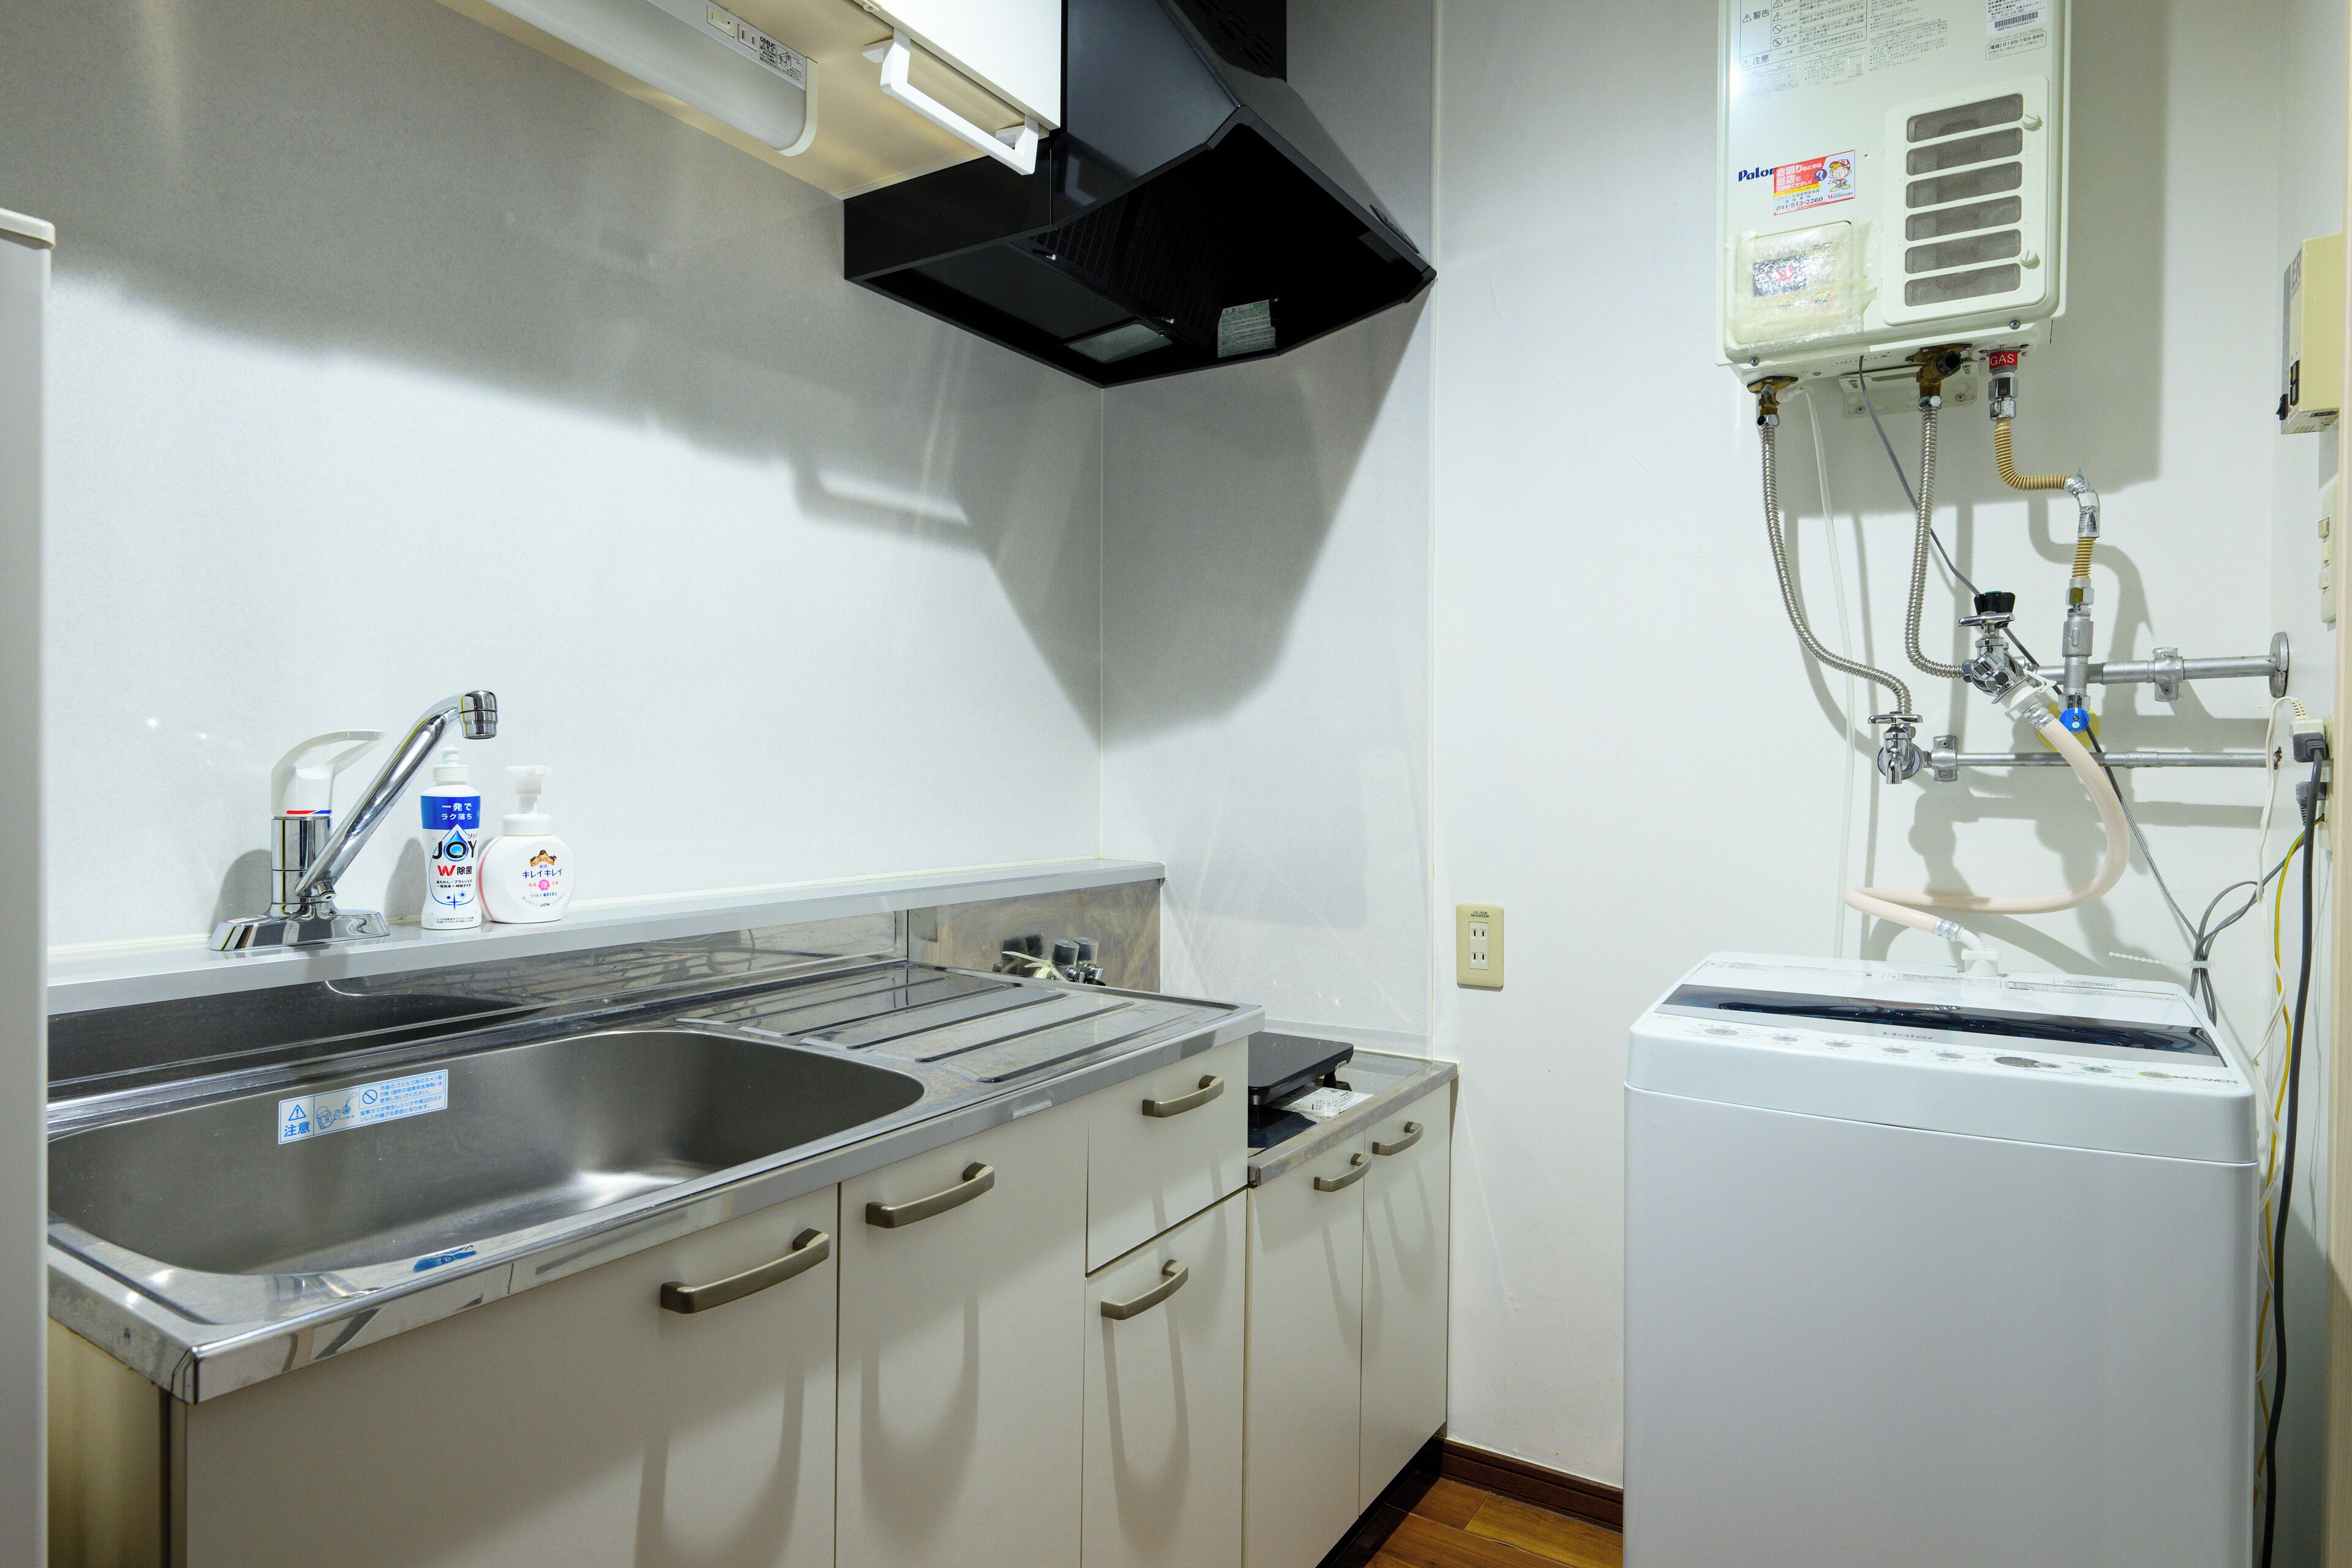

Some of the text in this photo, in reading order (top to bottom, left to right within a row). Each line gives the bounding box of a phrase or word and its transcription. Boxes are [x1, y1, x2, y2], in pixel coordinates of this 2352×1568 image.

[1753, 9, 1770, 20] 警告
[760, 37, 776, 49] ODELIC
[1752, 54, 1770, 65] 注意
[1777, 163, 1822, 177] お困りのときは
[1777, 174, 1801, 187] 当店に
[1776, 197, 1823, 211] 011-513-2260
[1990, 353, 2015, 366] GAS
[442, 802, 472, 811] 一発で
[432, 840, 477, 859] JOY
[522, 869, 562, 878] キレイキレイ
[1883, 1031, 1934, 1040] Haier
[380, 1090, 430, 1103] 使用しないでください。
[284, 1120, 310, 1137] 注意
